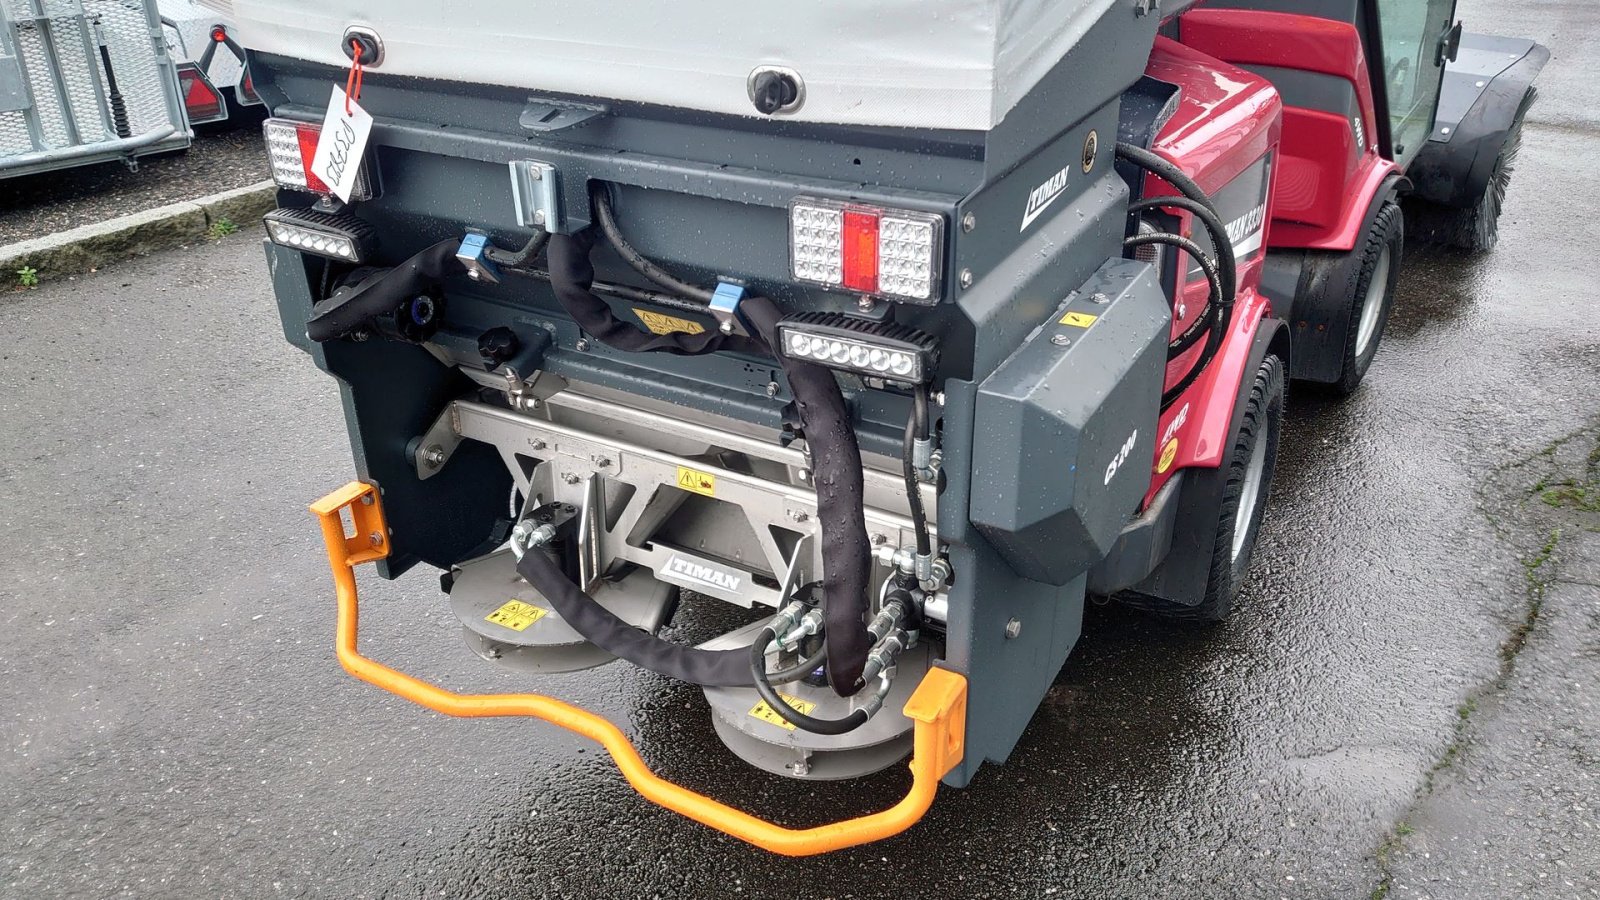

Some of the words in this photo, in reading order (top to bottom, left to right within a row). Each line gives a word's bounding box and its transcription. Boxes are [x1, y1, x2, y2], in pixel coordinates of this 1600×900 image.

[1029, 164, 1070, 213] TIMAN
[1224, 213, 1249, 244] MAN
[1159, 402, 1190, 452] 4WD
[673, 557, 741, 591] TIMAN
